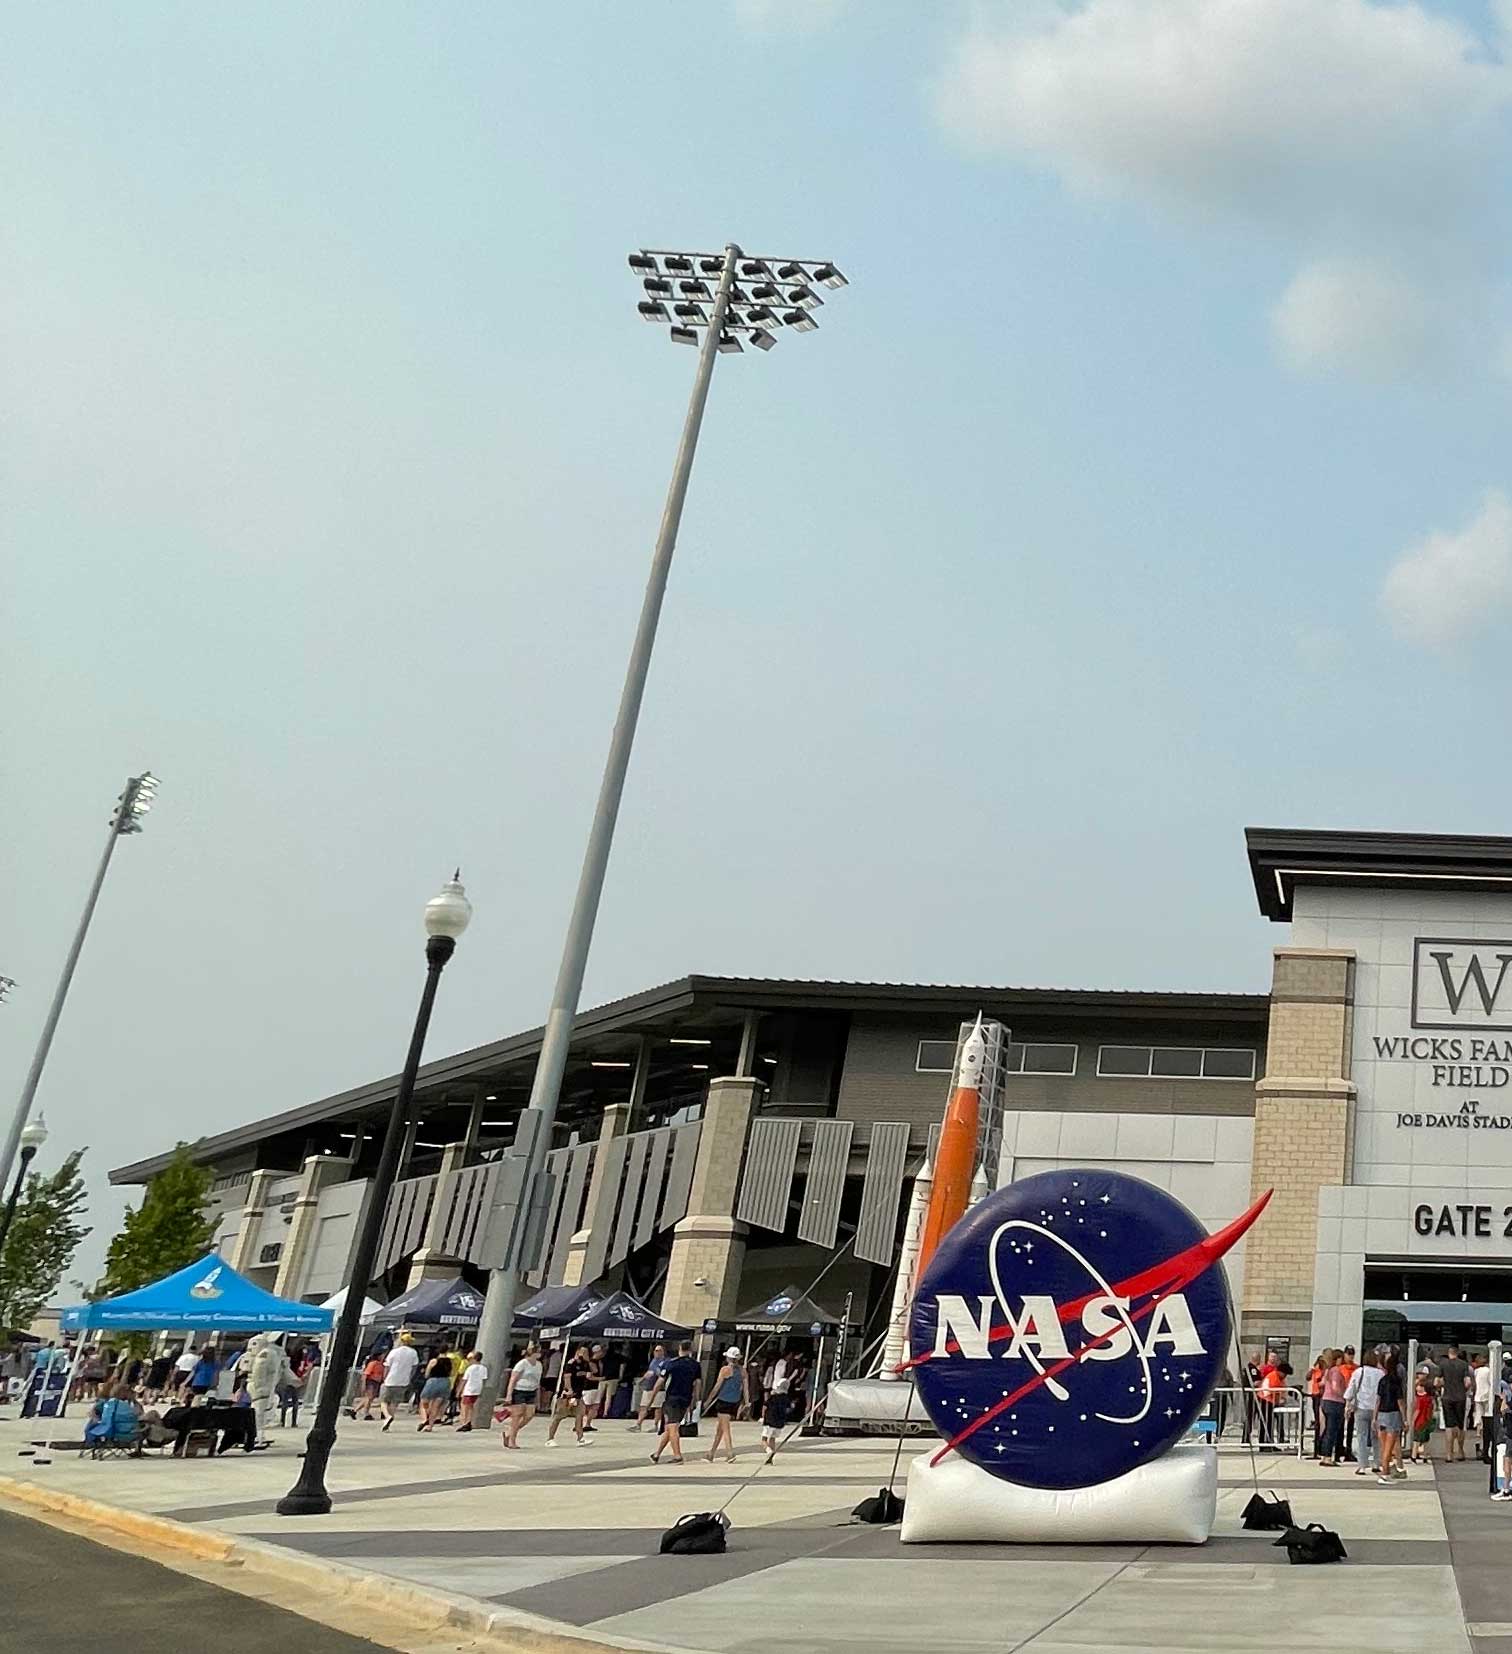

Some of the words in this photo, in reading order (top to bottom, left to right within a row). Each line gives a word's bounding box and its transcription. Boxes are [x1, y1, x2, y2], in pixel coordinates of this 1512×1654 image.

[1373, 1036, 1463, 1060] WICKS
[1432, 1065, 1510, 1088] FIELD
[1459, 1101, 1479, 1114] AT
[1396, 1114, 1423, 1128] JOE
[1425, 1115, 1470, 1128] DAVIS
[1415, 1204, 1492, 1236] GATE
[930, 1293, 1208, 1364] NASA
